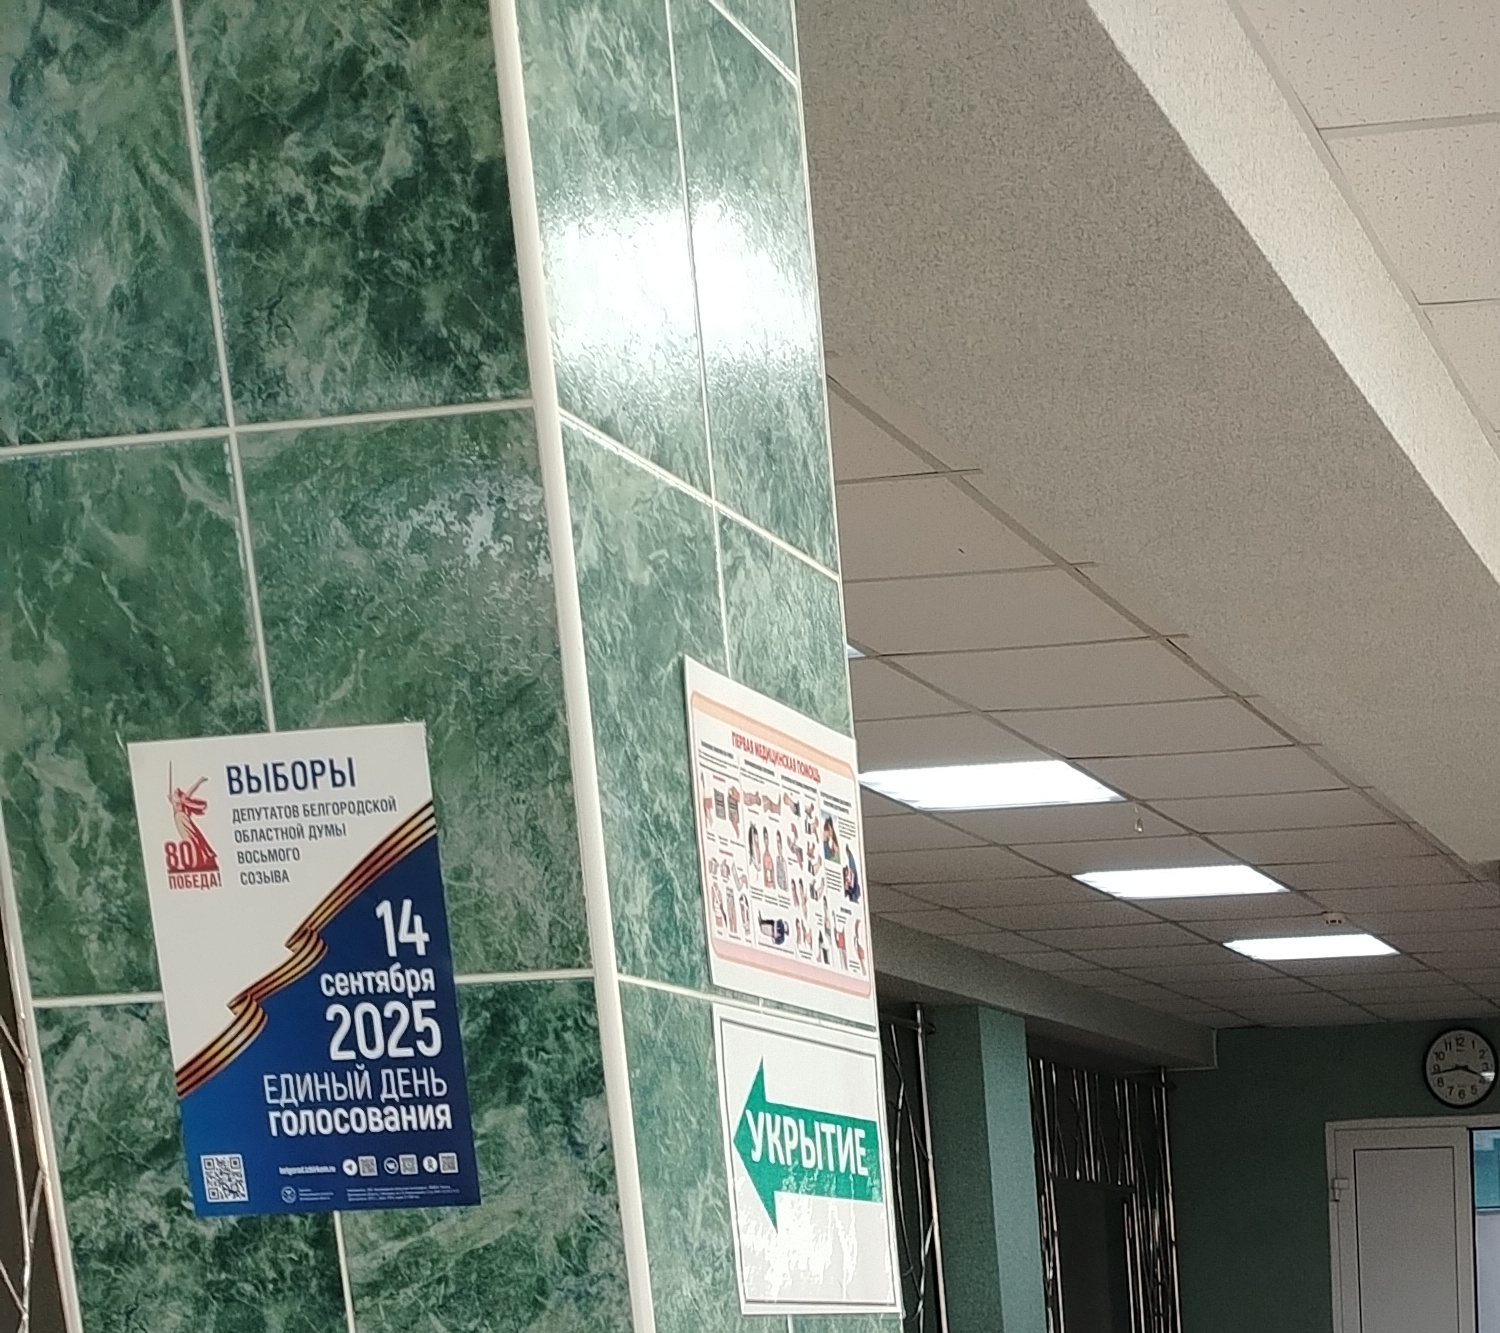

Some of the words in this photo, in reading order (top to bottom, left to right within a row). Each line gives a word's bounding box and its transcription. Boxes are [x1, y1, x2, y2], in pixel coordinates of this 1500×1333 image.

[225, 757, 356, 796] ВЫБОРЫ
[232, 804, 300, 824] ДЕПУТАТОВ
[302, 796, 397, 817] БЕЛГОРОДСКОЙ
[234, 823, 305, 843] ОБЛАСТНОЙ
[308, 823, 347, 842] ДУМЫ
[165, 841, 194, 871] 80
[237, 847, 301, 865] ВОСЬМОГО
[168, 872, 222, 890] ПОБЕДА!
[240, 869, 290, 886] СОЗЫВА
[375, 899, 431, 957] 14
[320, 962, 436, 999] сентября
[325, 1000, 442, 1061] 2025
[1456, 1037, 1465, 1047] 12
[1444, 1040, 1452, 1051] 11
[263, 1063, 373, 1107] ЕДИНЫЙ
[380, 1067, 448, 1103] ДЕНЬ
[744, 1109, 870, 1177] УКРЫТИЕ
